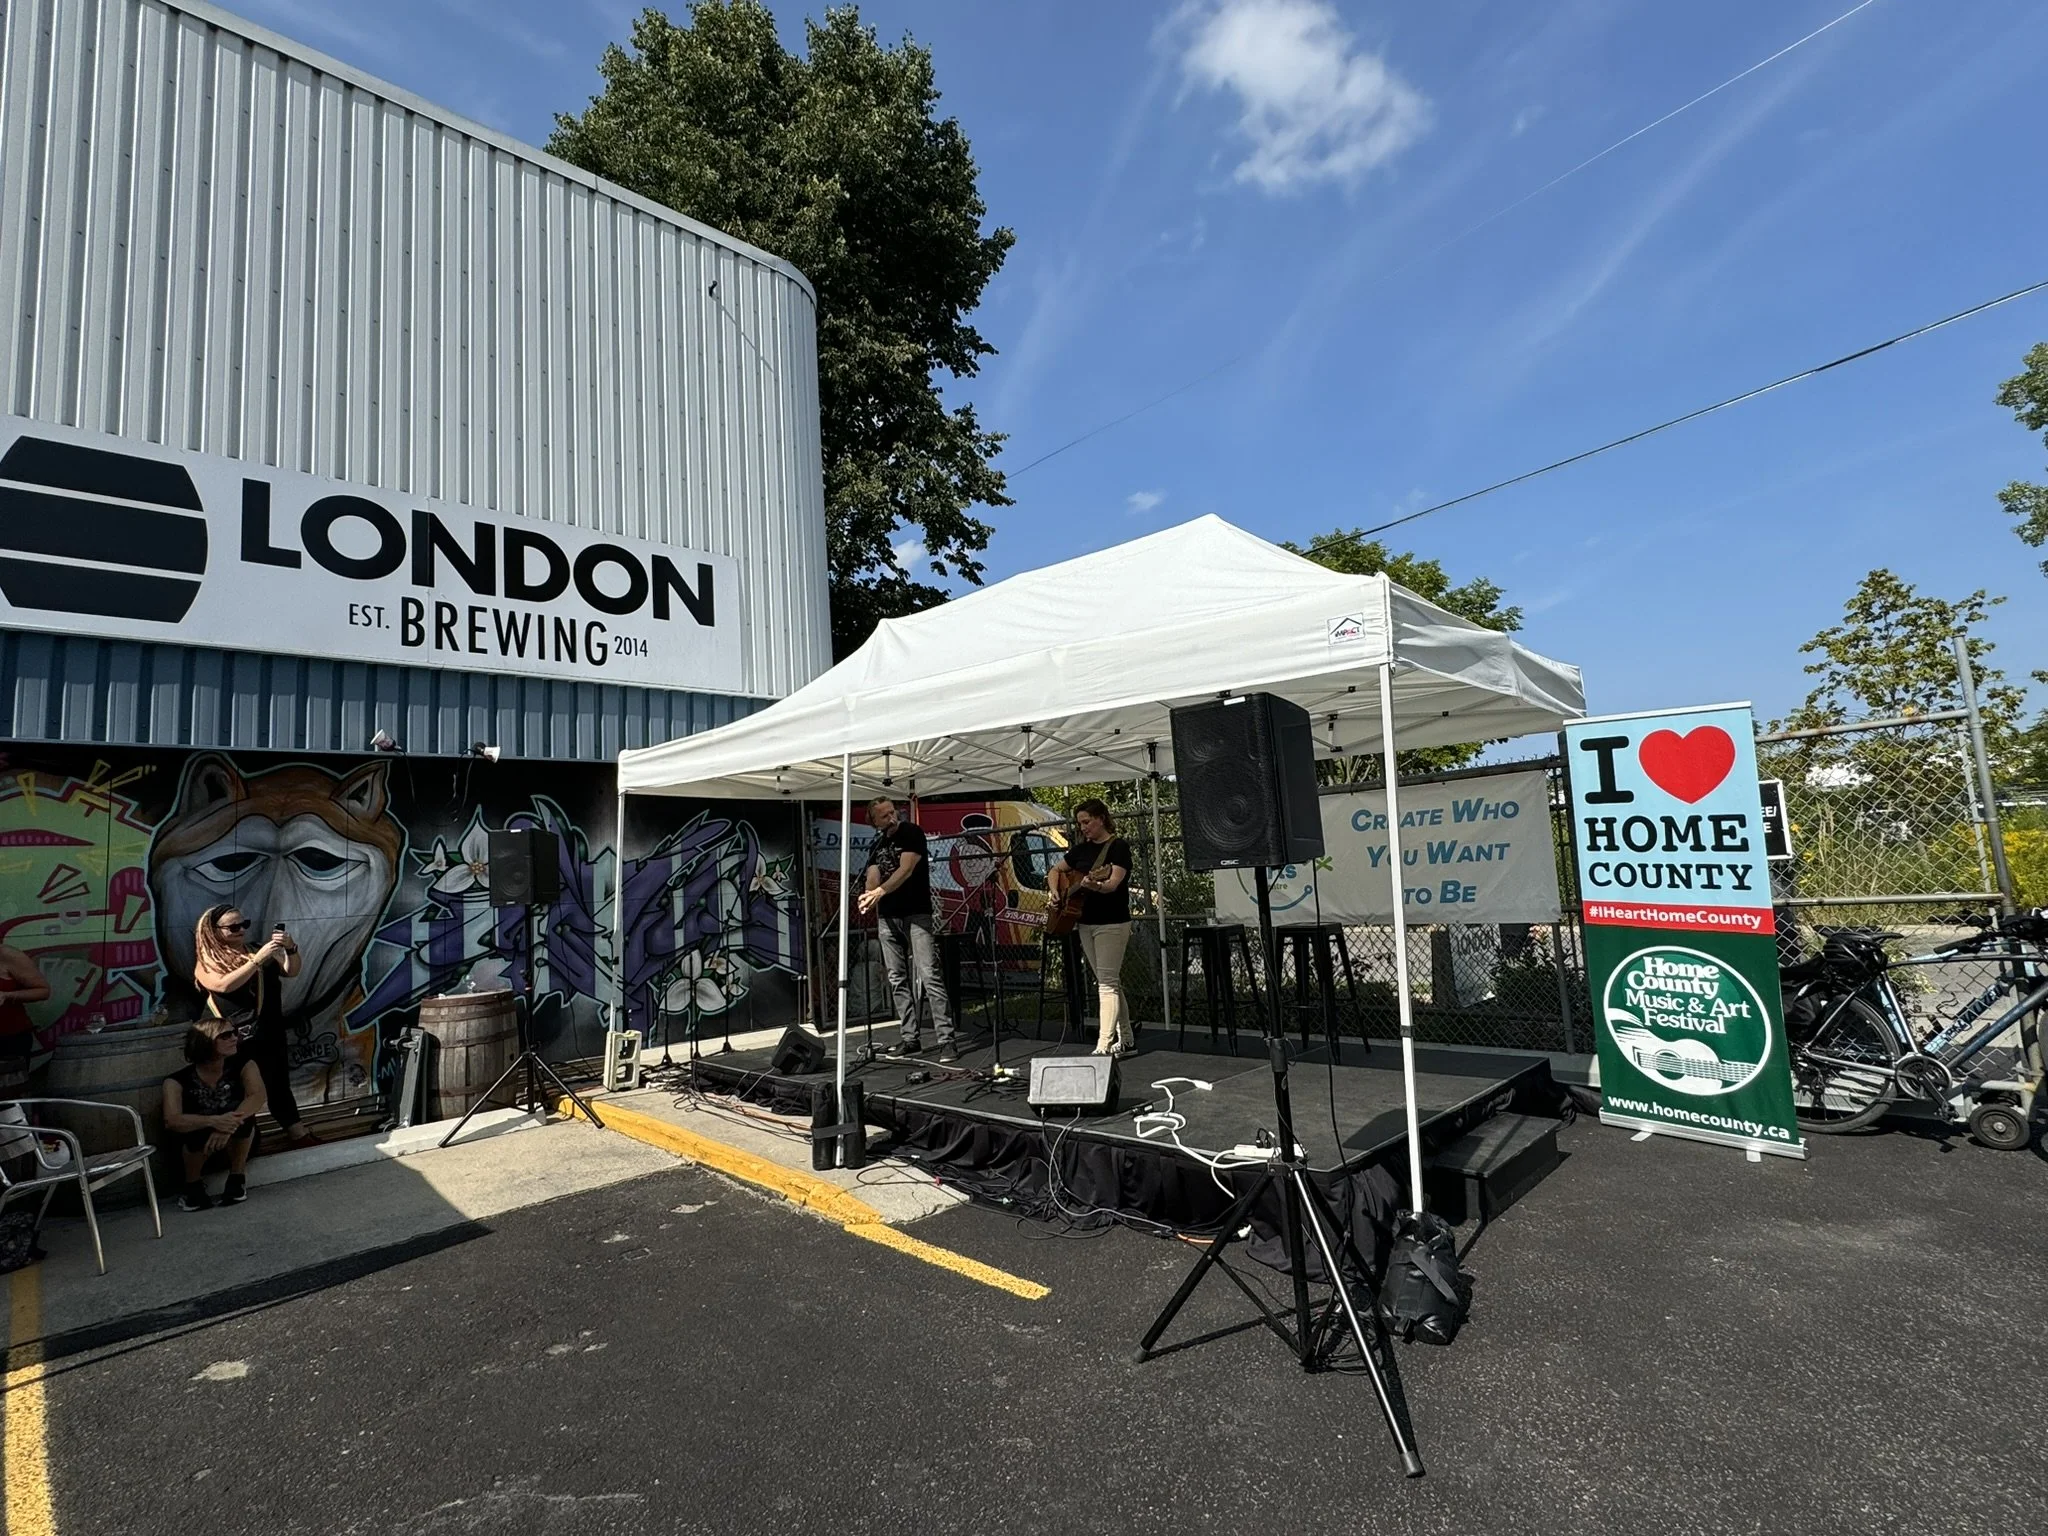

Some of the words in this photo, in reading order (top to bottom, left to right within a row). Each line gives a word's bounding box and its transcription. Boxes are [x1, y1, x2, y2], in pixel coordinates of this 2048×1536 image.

[241, 478, 714, 627] LONDON
[349, 603, 390, 629] EST.
[401, 598, 608, 666] BREWING
[614, 635, 648, 657] 2014
[1580, 736, 1634, 804] I
[1351, 808, 1444, 832] CRATE
[1584, 814, 1749, 853] HOME
[1367, 845, 1418, 868] YU
[1589, 862, 1752, 890] COUNTY
[1589, 906, 1761, 929] #IHeartHomeCounty
[1643, 956, 1720, 979] Home
[1627, 970, 1719, 999] County
[1625, 988, 1684, 1011] Music
[1688, 997, 1706, 1013] &
[1709, 998, 1751, 1018] Art
[1643, 1007, 1726, 1034] Festival
[1608, 1095, 1790, 1139] www.homecounty.ca
